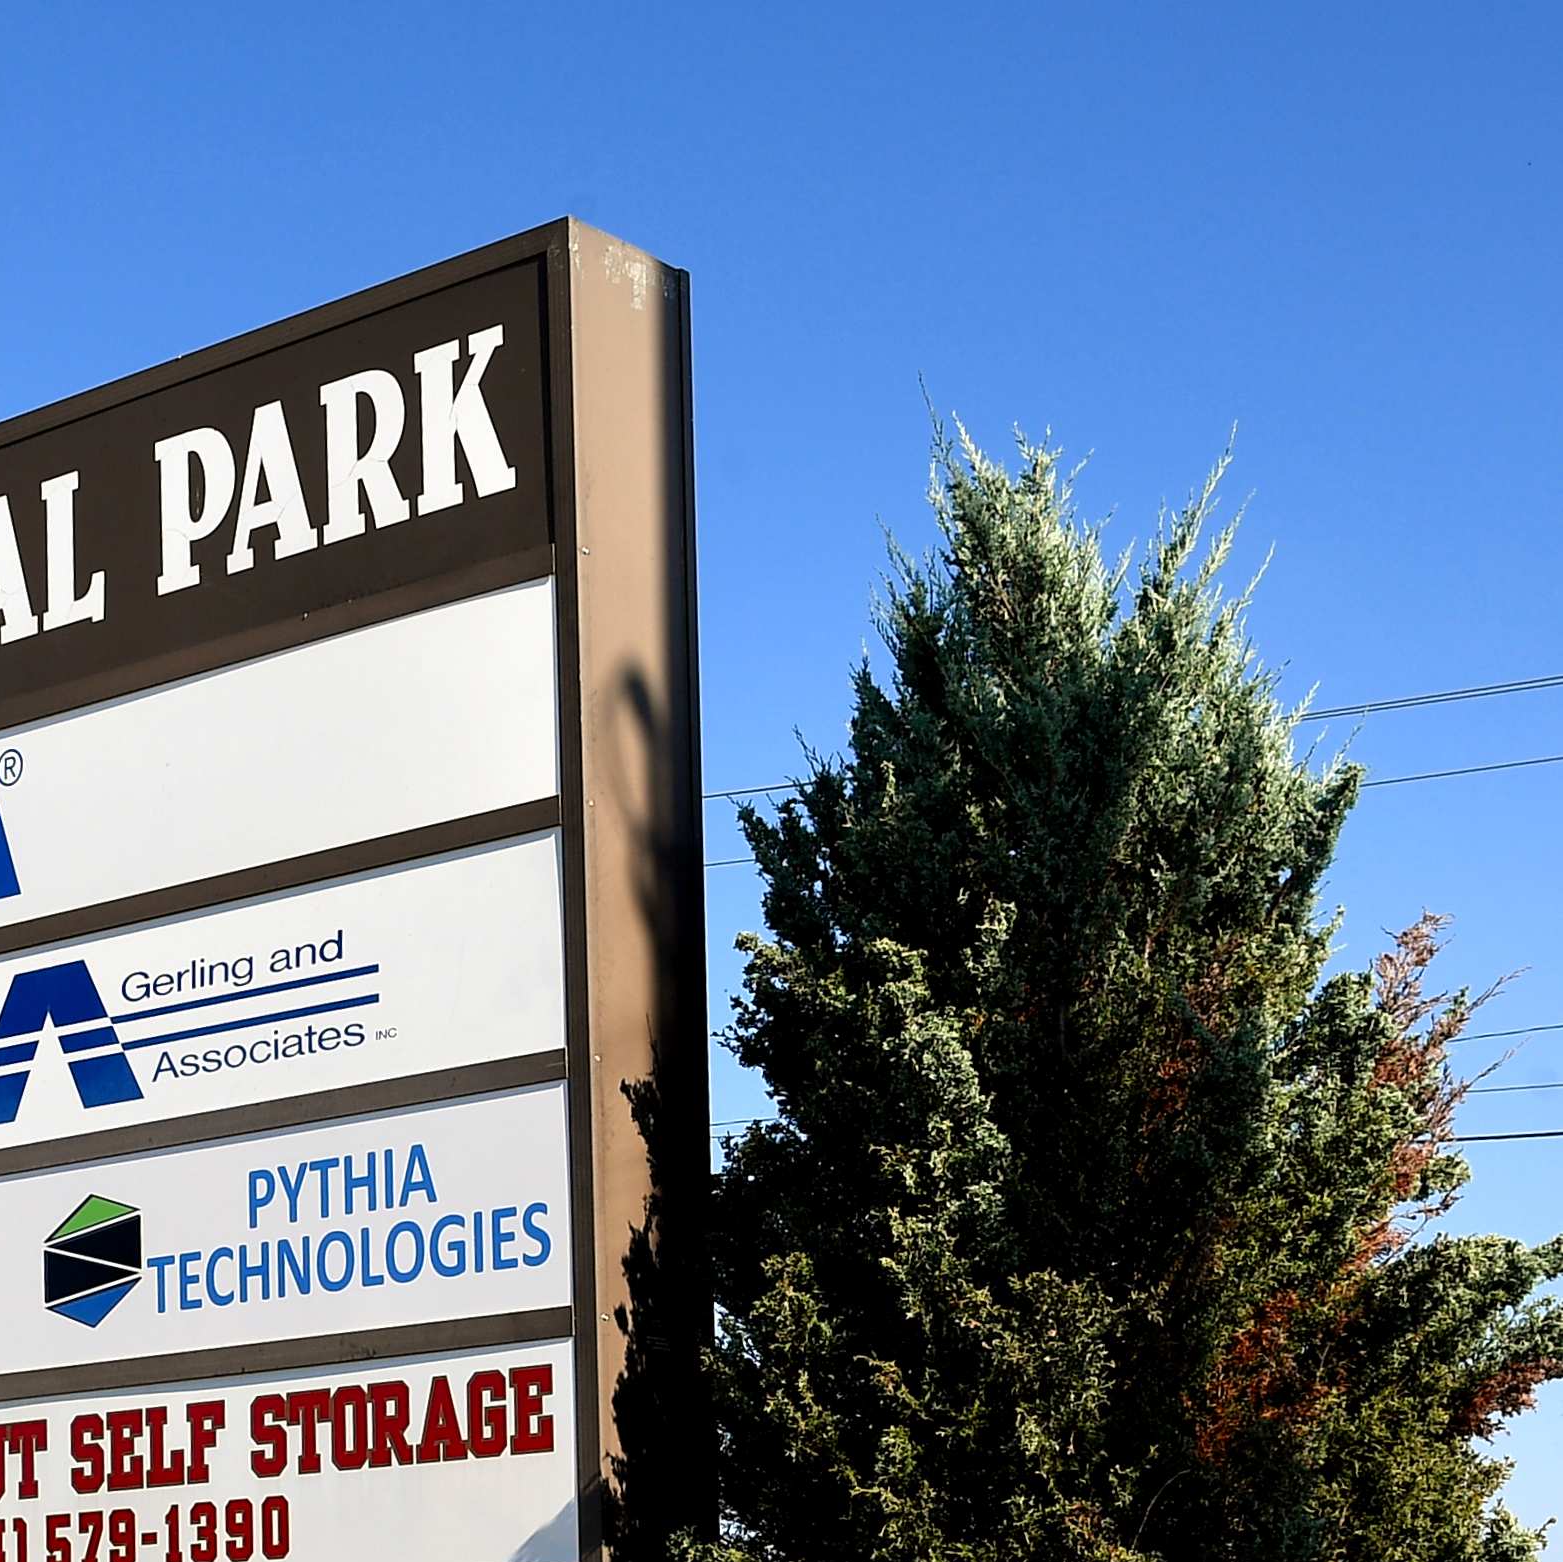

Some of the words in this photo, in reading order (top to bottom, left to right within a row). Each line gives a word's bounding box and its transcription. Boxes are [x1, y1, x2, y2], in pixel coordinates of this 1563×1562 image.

[154, 325, 517, 595] PARK
[121, 955, 254, 1002] Gerling
[270, 930, 343, 972] and
[152, 1022, 365, 1083] Associates
[375, 1027, 398, 1041] INC
[248, 1144, 437, 1228] PYTHIA
[147, 1201, 552, 1313] TECHNOLOGIES
[71, 1400, 226, 1494] SELF
[251, 1363, 555, 1478] STORAGE
